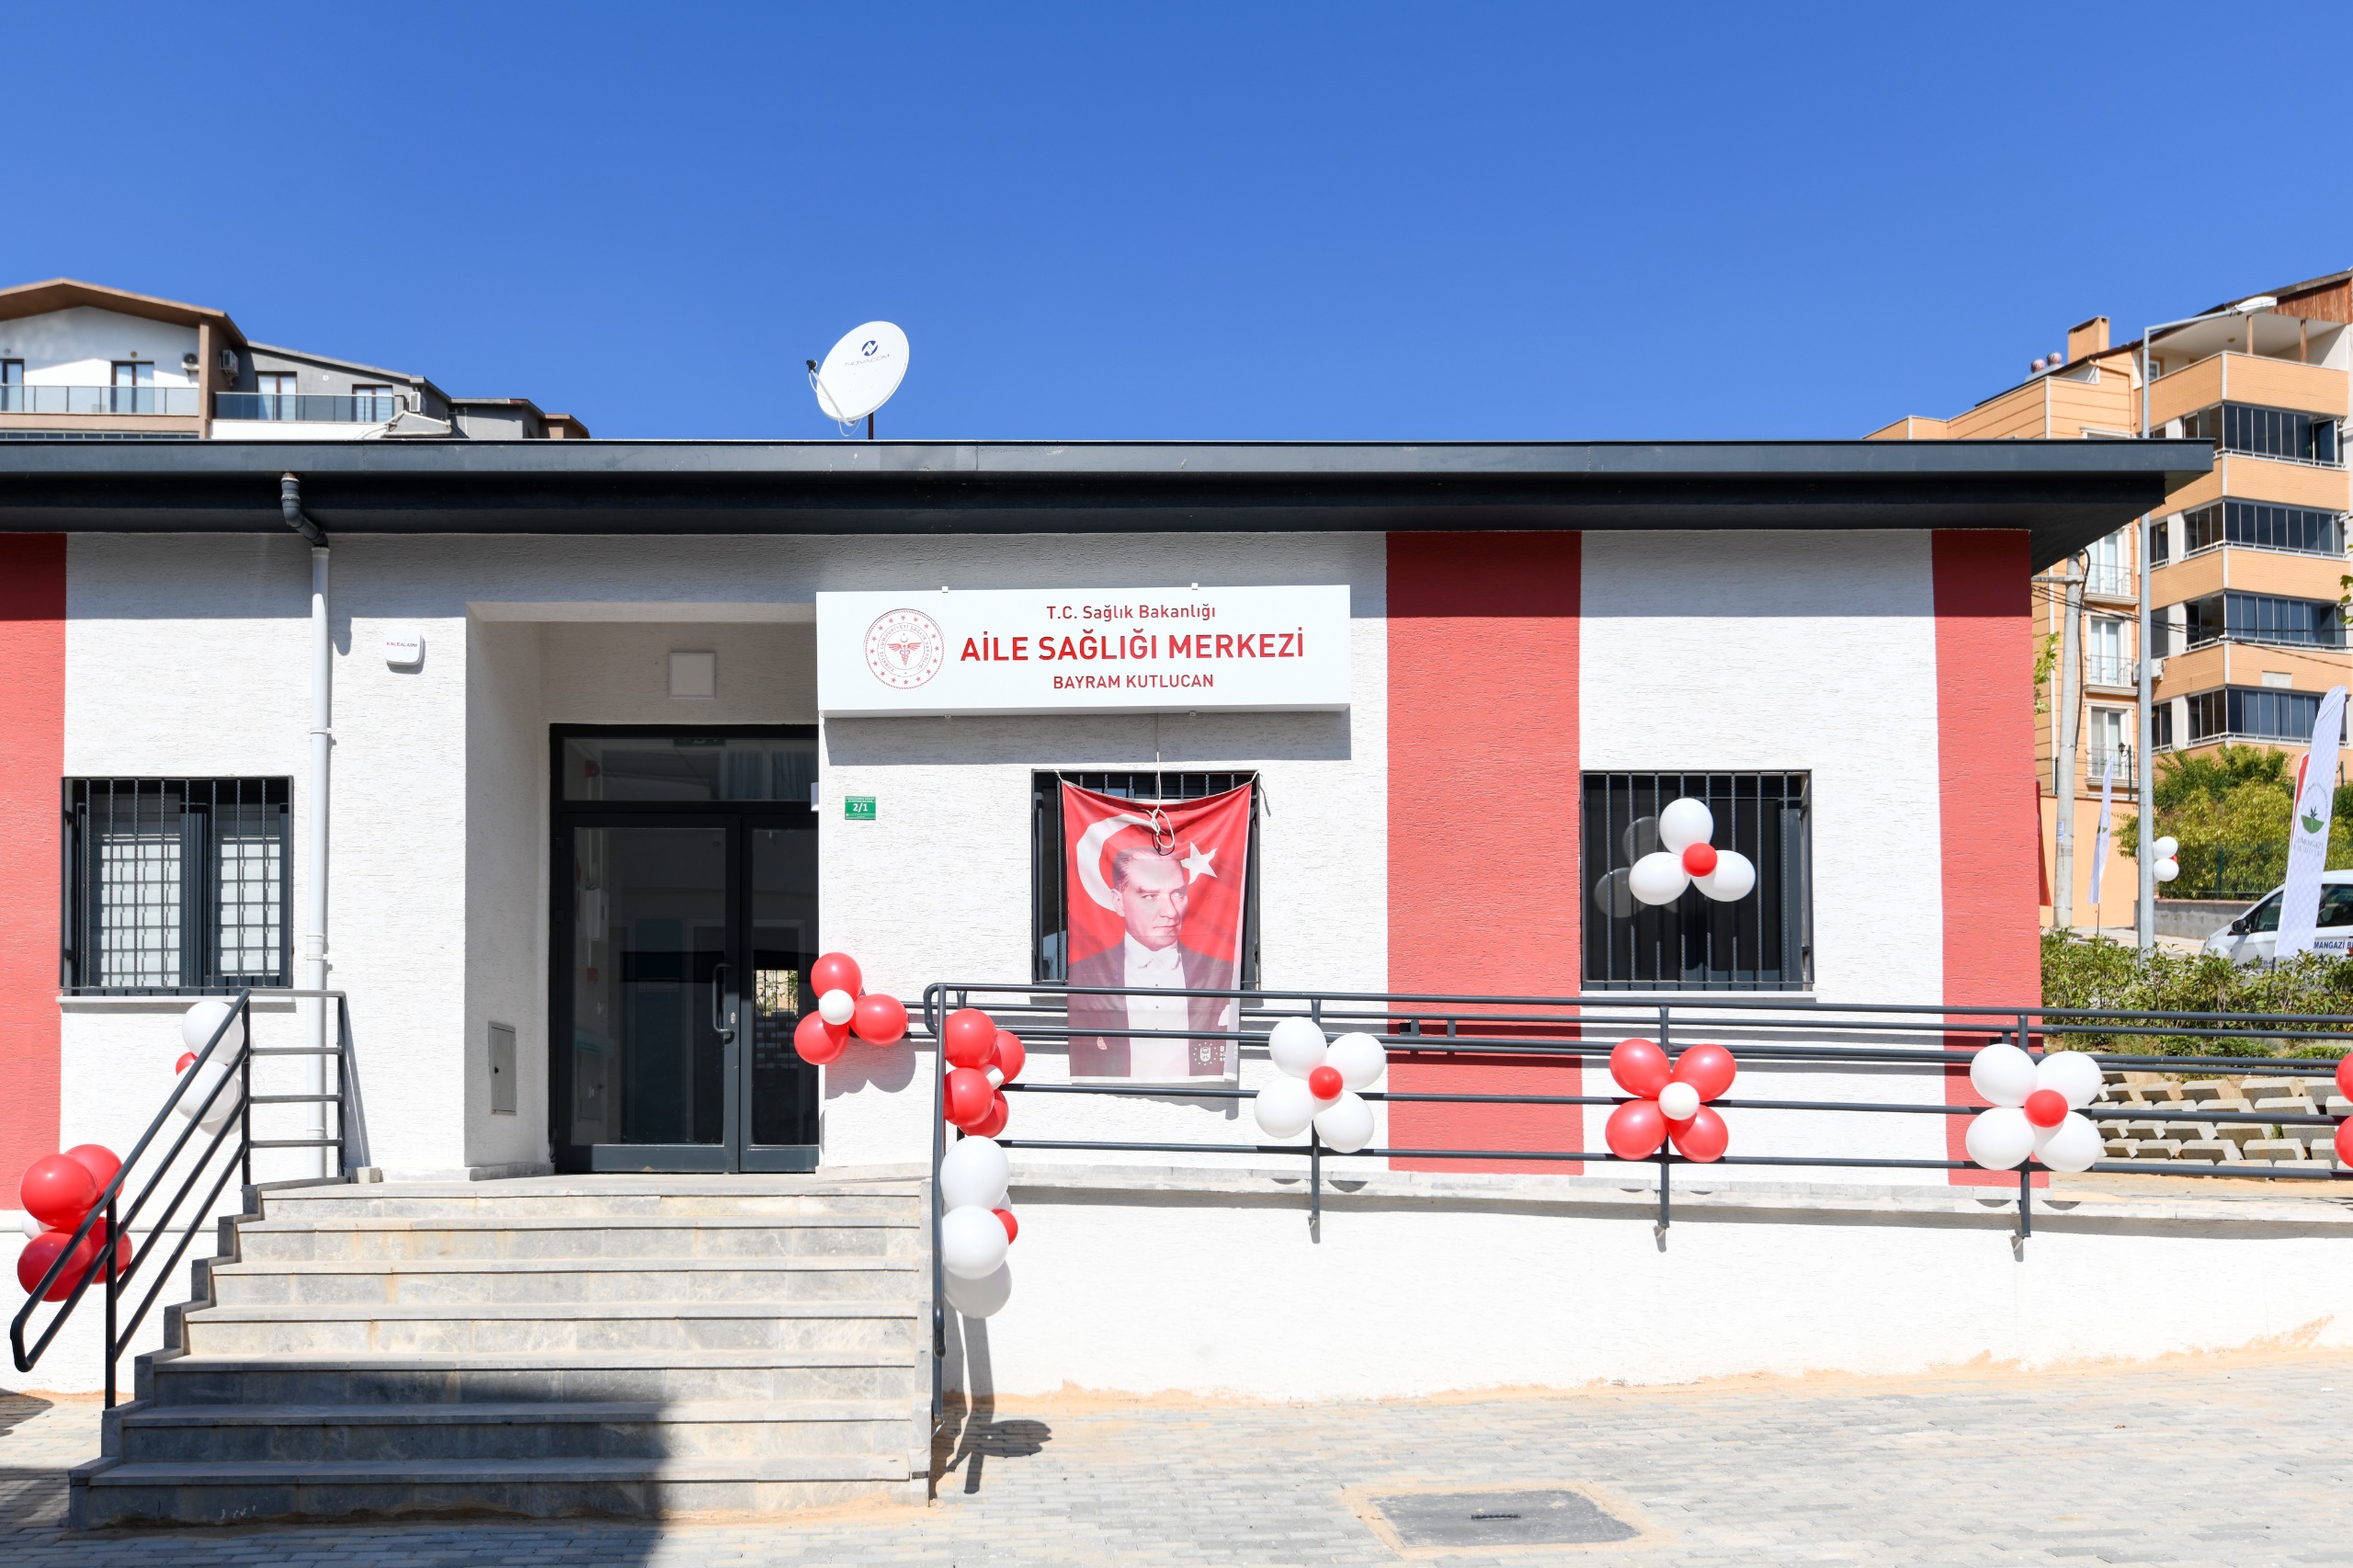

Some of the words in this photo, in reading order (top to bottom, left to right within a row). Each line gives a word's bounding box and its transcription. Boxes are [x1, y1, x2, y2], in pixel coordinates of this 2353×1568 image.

[1047, 606, 1077, 619] T.C.
[1083, 603, 1133, 620] Sağlık
[1139, 603, 1216, 619] Bakanlığı
[961, 631, 1029, 661] AİLE
[1039, 629, 1157, 661] SAĞLIĞI
[1168, 626, 1303, 659] MERKEZİ
[1053, 676, 1120, 689] BAYRAM
[1126, 674, 1214, 688] KUTLUCAN
[853, 802, 868, 812] 2/1
